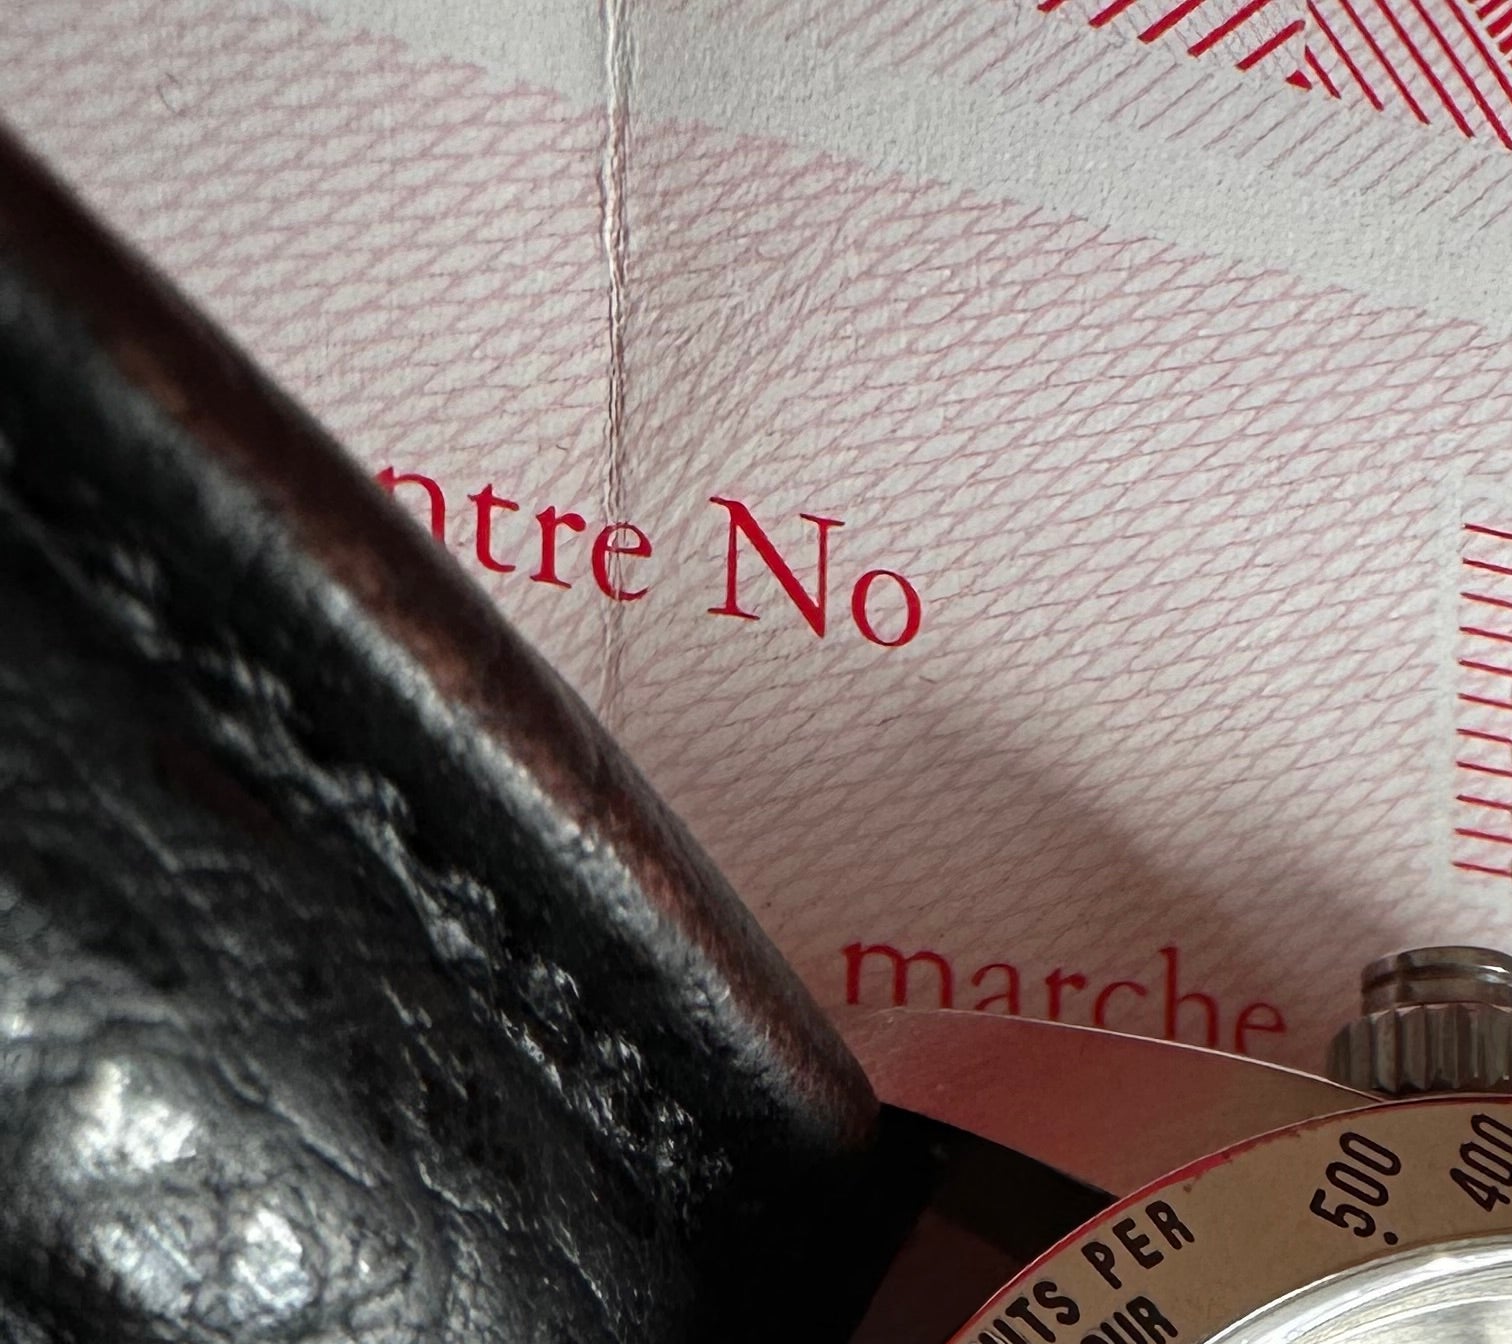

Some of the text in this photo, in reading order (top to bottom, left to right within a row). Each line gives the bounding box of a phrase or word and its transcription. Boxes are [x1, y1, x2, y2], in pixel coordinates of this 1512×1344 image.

[709, 496, 923, 648] No
[841, 941, 1288, 1053] marche
[1309, 1131, 1402, 1238] 500
[1081, 1200, 1195, 1290] PER
